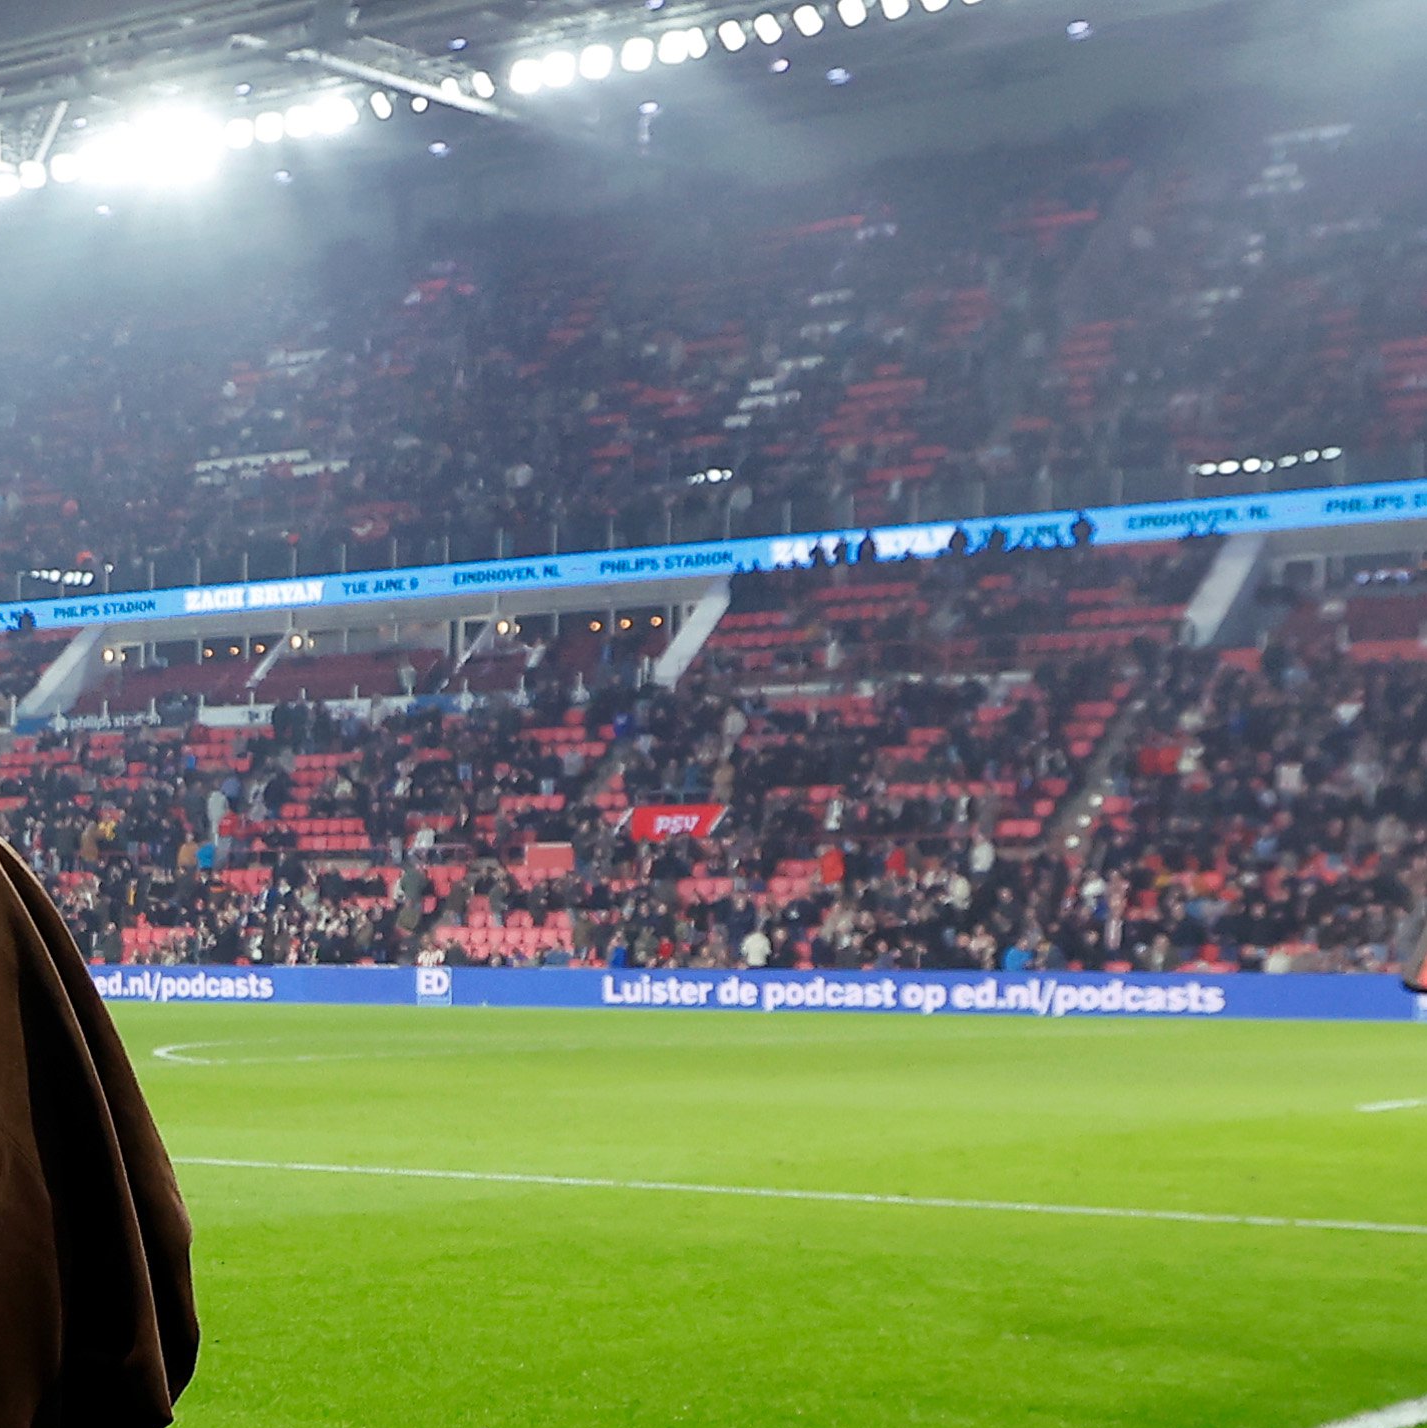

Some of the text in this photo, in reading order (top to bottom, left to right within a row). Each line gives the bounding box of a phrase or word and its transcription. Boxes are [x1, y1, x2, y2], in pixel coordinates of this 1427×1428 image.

[600, 550, 733, 575] PHILIPS STADION
[104, 600, 157, 616] STADION
[185, 582, 325, 612] ZACH BRYAN
[654, 813, 701, 835] PSV
[97, 971, 274, 1002] ed.nl/podcasts
[418, 969, 448, 996] ED
[602, 974, 1227, 1017] Luister de podcast op ed.nl/podcasts
